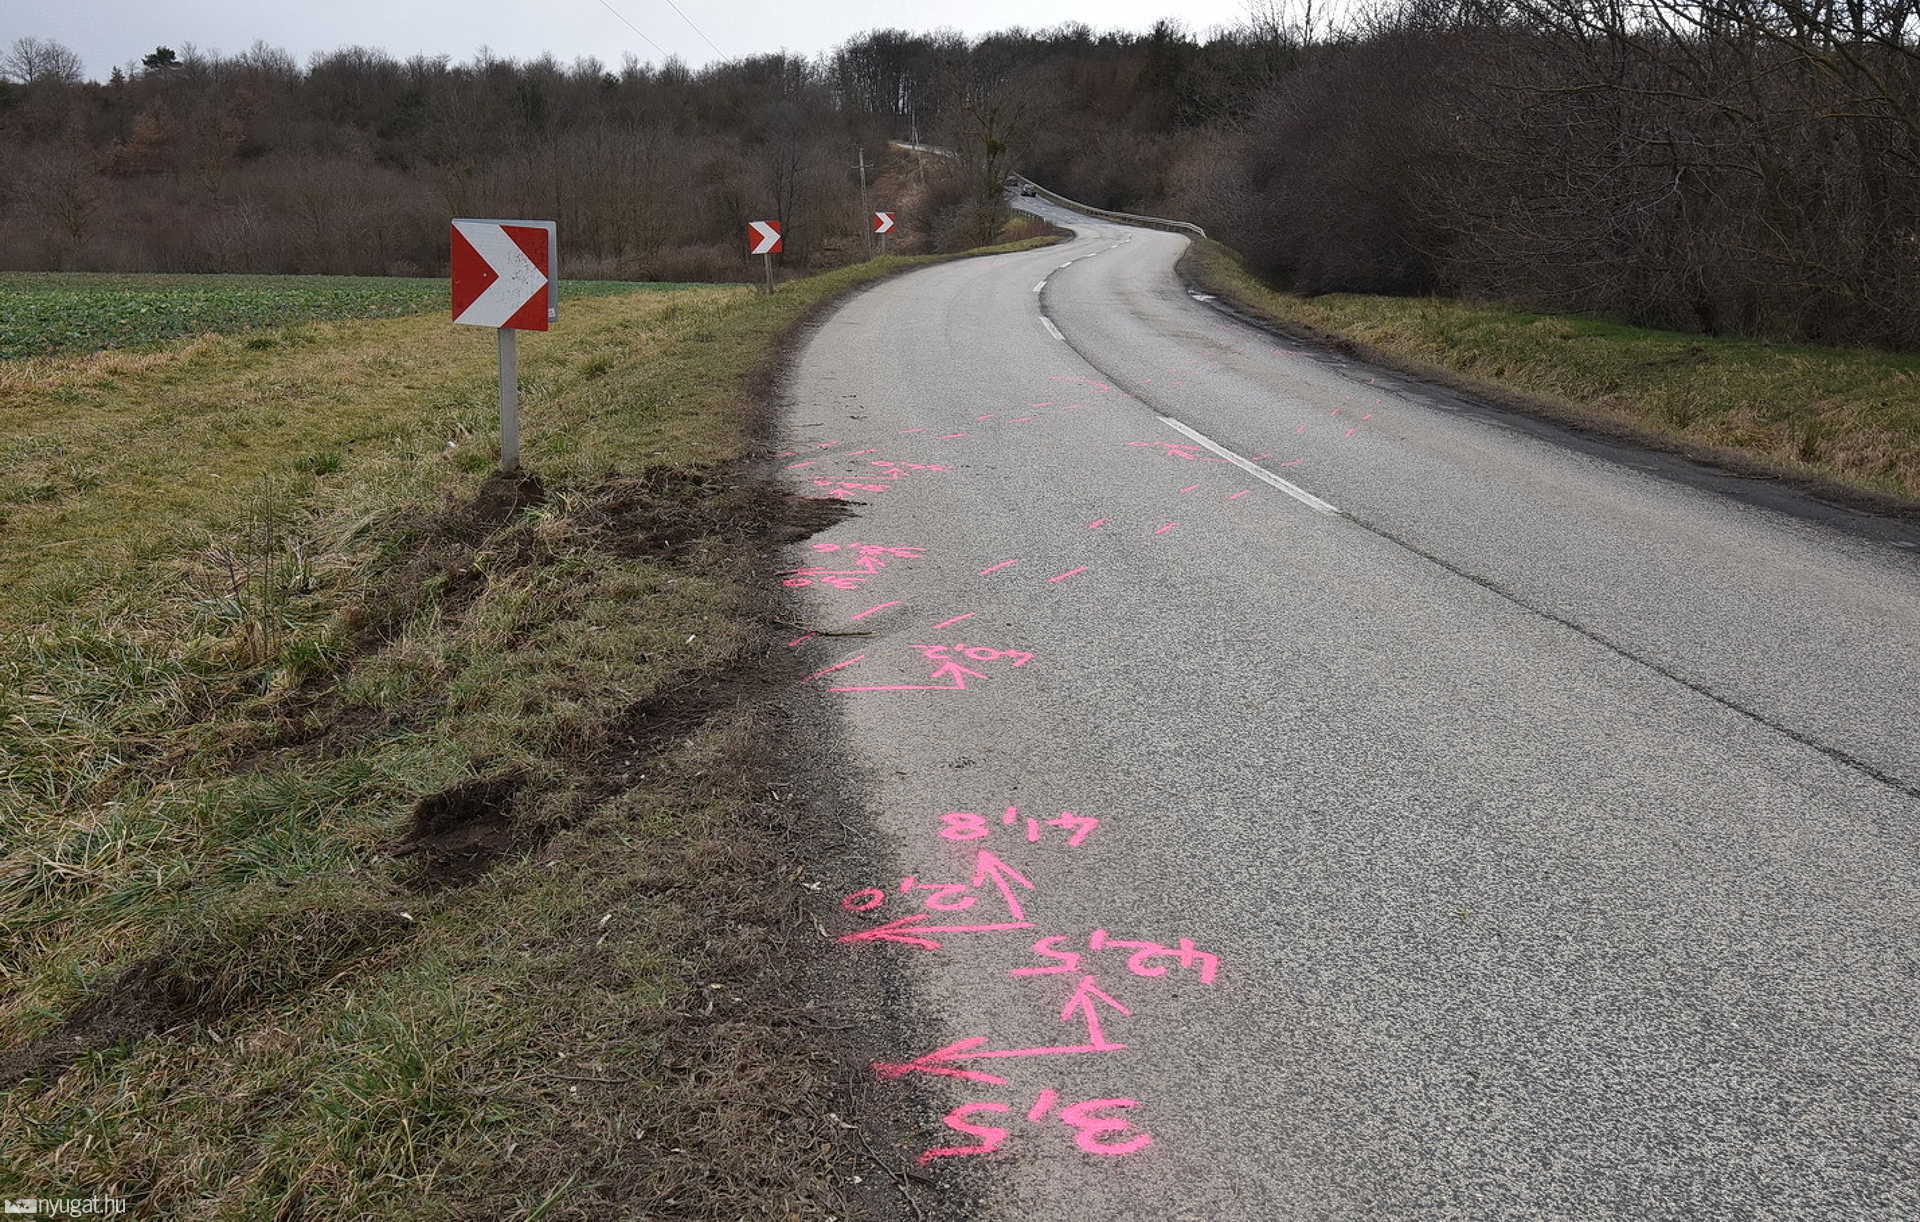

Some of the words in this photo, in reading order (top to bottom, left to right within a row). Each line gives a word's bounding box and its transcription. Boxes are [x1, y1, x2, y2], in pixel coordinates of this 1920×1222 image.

[936, 806, 1100, 847] 41,8
[840, 876, 977, 912] 2,0
[1010, 928, 1223, 985] 42,5
[914, 1088, 1153, 1167] 3,5
